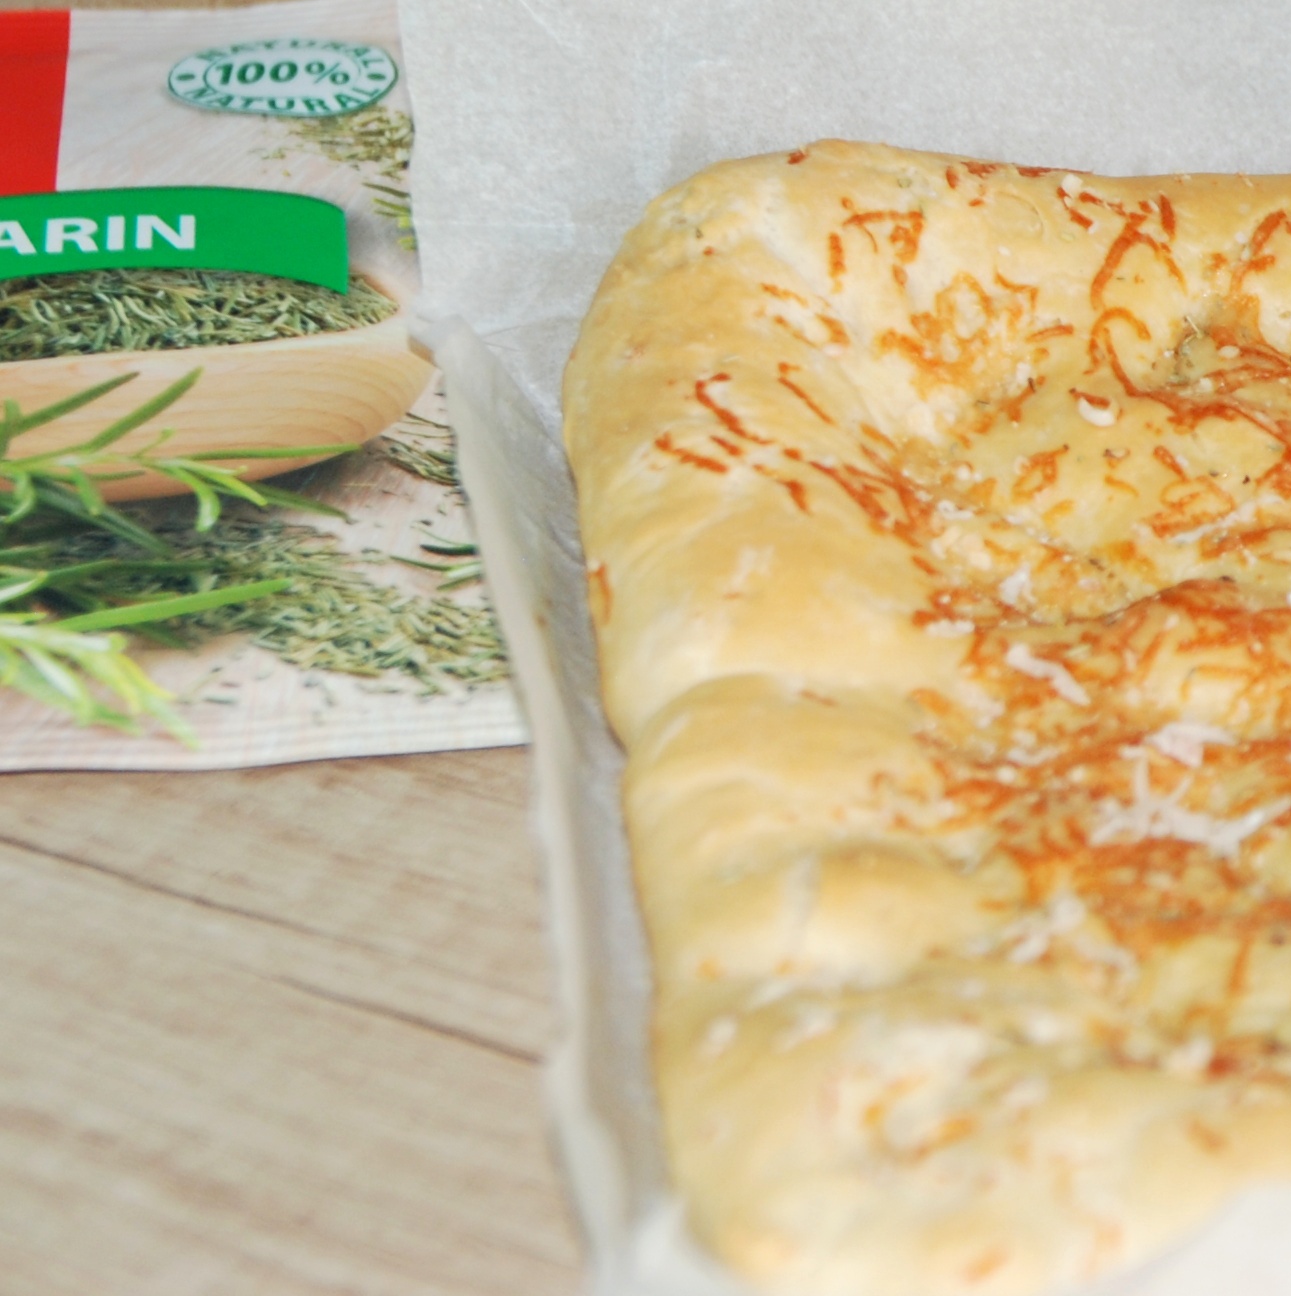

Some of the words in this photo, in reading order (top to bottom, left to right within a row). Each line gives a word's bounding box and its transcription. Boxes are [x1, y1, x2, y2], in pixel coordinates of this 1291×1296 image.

[214, 60, 351, 86] 100%
[184, 87, 382, 111] NATURAL
[0, 214, 196, 255] ARIN
